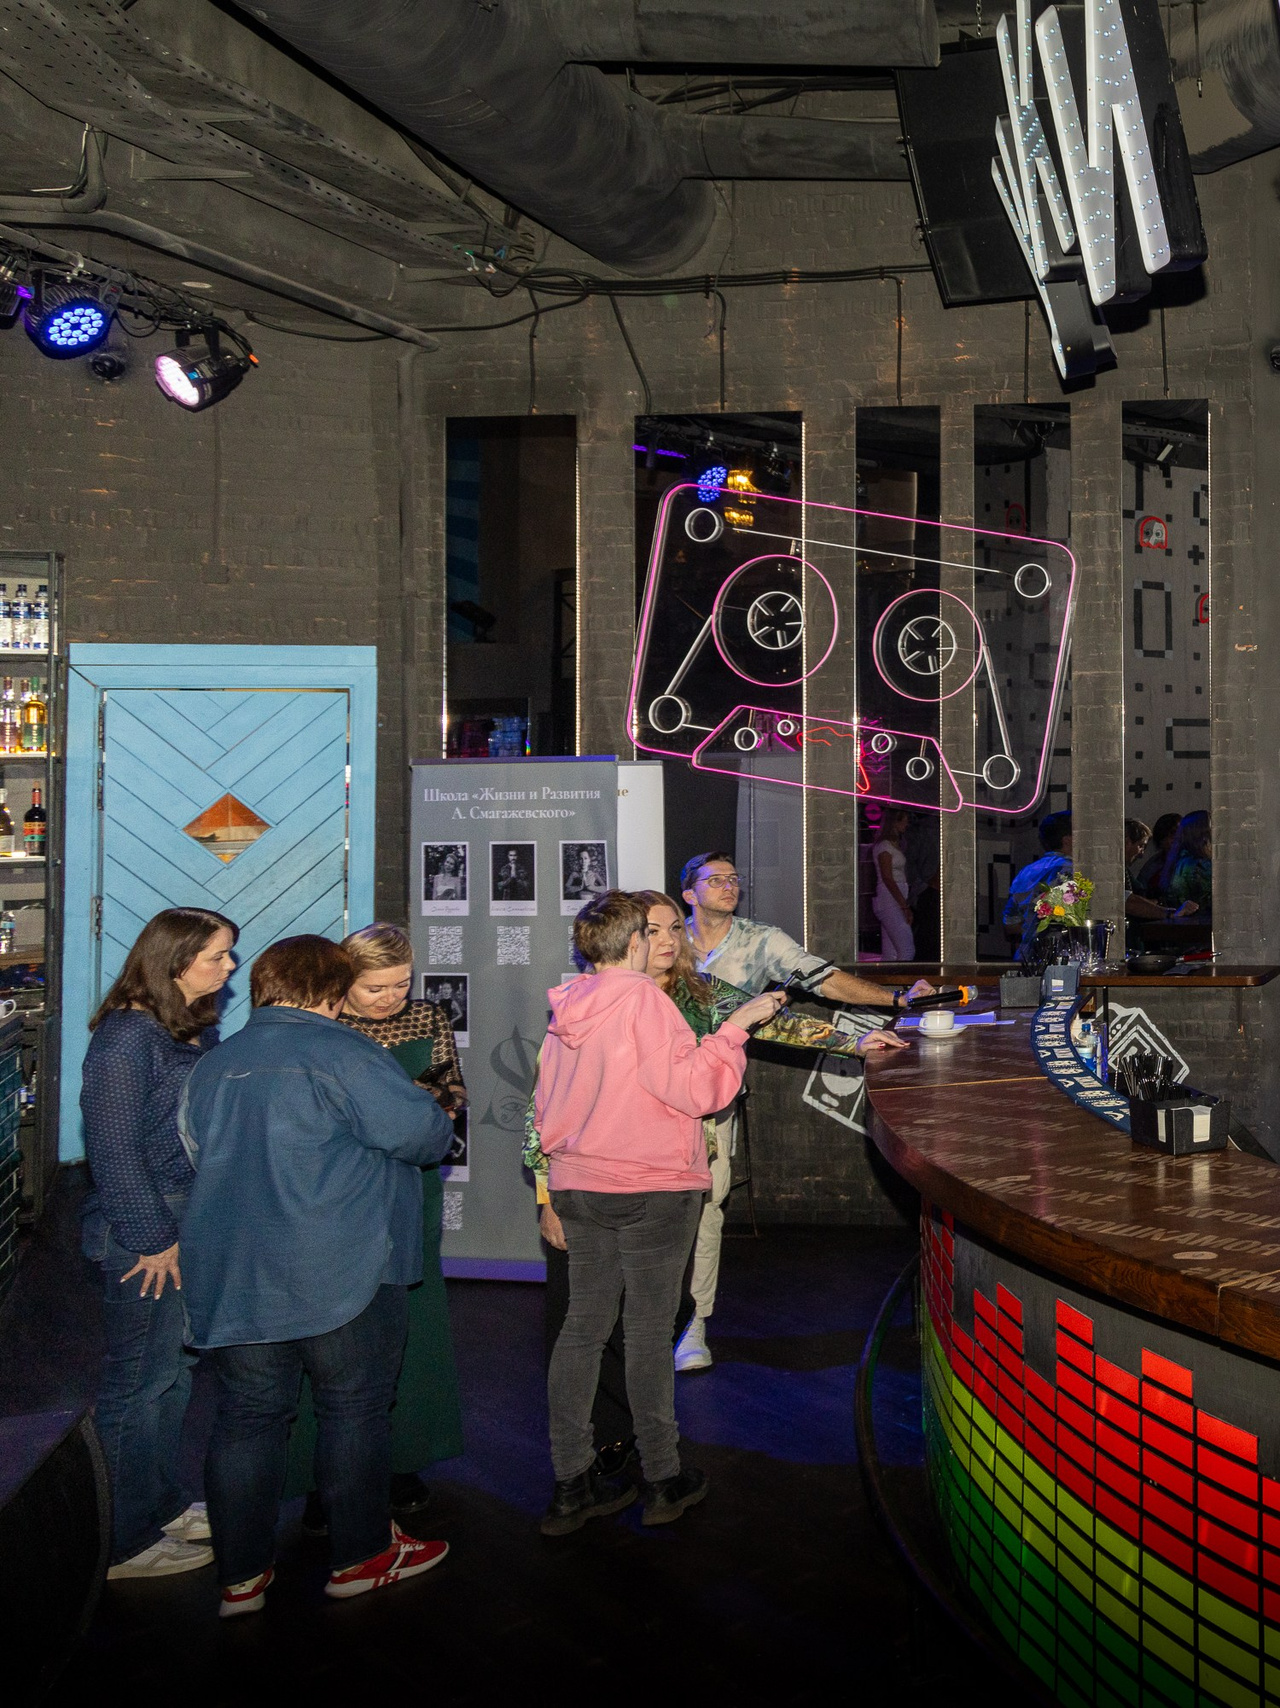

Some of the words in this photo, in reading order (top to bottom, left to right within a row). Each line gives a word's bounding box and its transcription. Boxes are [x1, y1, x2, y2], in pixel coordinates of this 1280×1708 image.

[424, 788, 468, 802] Школа
[472, 787, 525, 801] «Жизни
[530, 790, 537, 800] и
[542, 787, 600, 800] Развития
